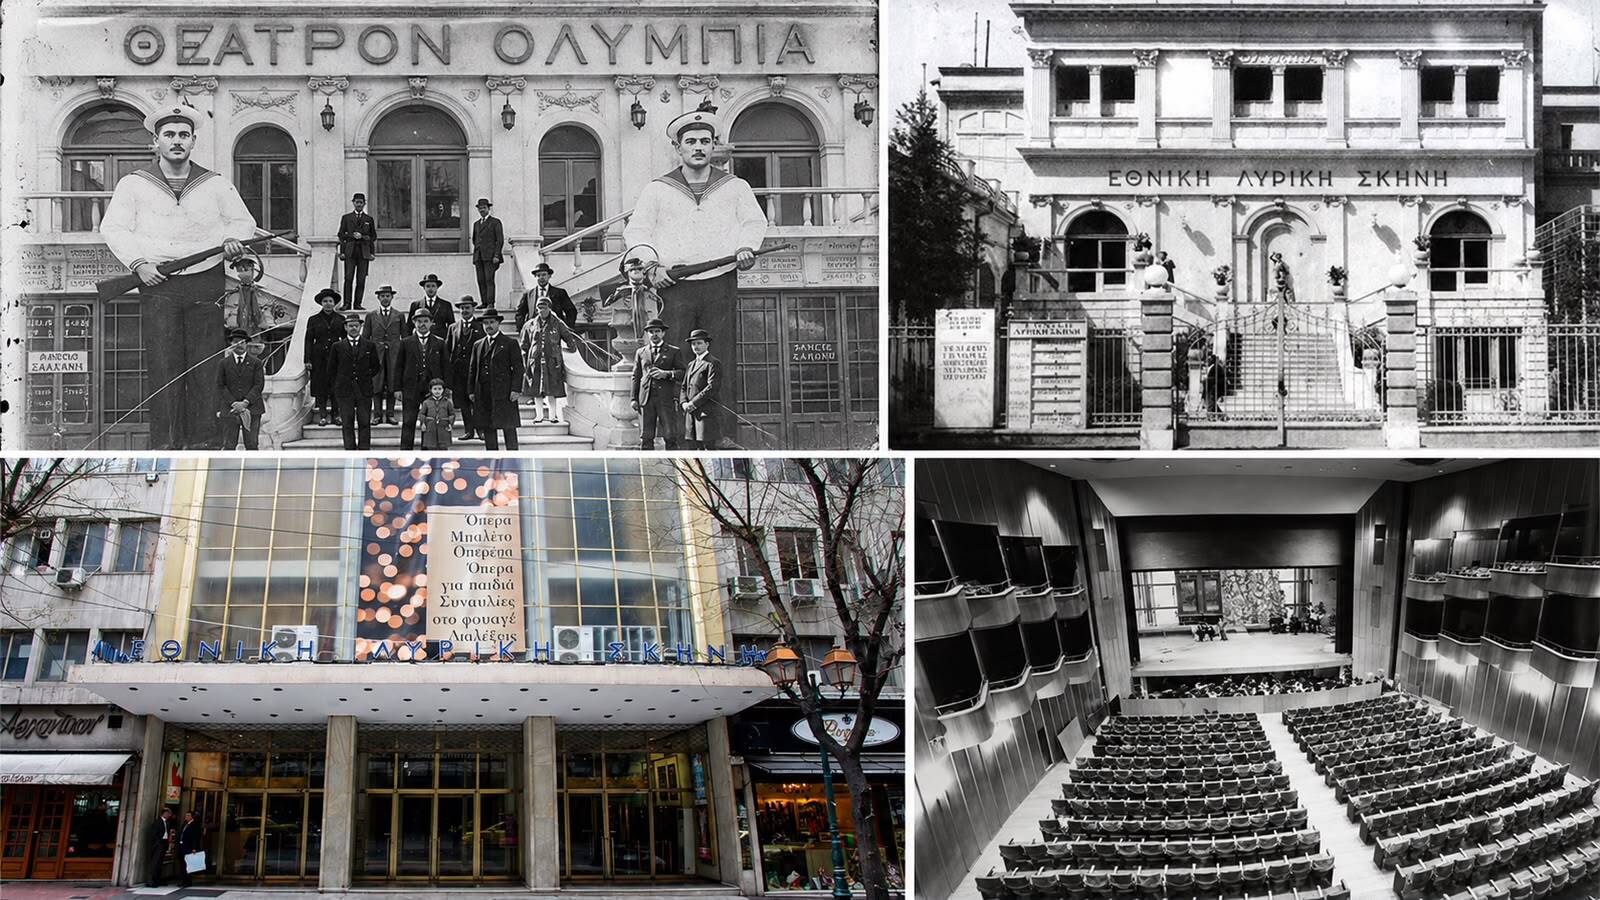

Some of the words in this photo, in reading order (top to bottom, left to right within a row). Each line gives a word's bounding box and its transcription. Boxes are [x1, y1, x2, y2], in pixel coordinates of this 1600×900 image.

[123, 23, 452, 66] ΘΕΑΤΡΟΝ
[493, 23, 816, 65] ΟΛΥΜΠΙΑ
[1108, 169, 1210, 188] ΕΘΝΙΚΗ
[1236, 169, 1333, 188] ΛΥΡΙΚΗ
[1356, 169, 1448, 188] ΣΚΗΝΗ
[464, 513, 512, 528] Όπερα
[451, 529, 513, 543] Μπαλέτο
[466, 561, 514, 577] Όπερα
[441, 581, 464, 594] για
[469, 578, 514, 590] παιδιά
[439, 595, 516, 609] Συναυλίες
[461, 611, 517, 629] φουαγέ
[130, 638, 314, 662] ΕΘΝΙΚΗ
[373, 639, 551, 662] ΛΥΡΙΚΗ
[607, 640, 759, 666] ΣΚΗΝΗ
